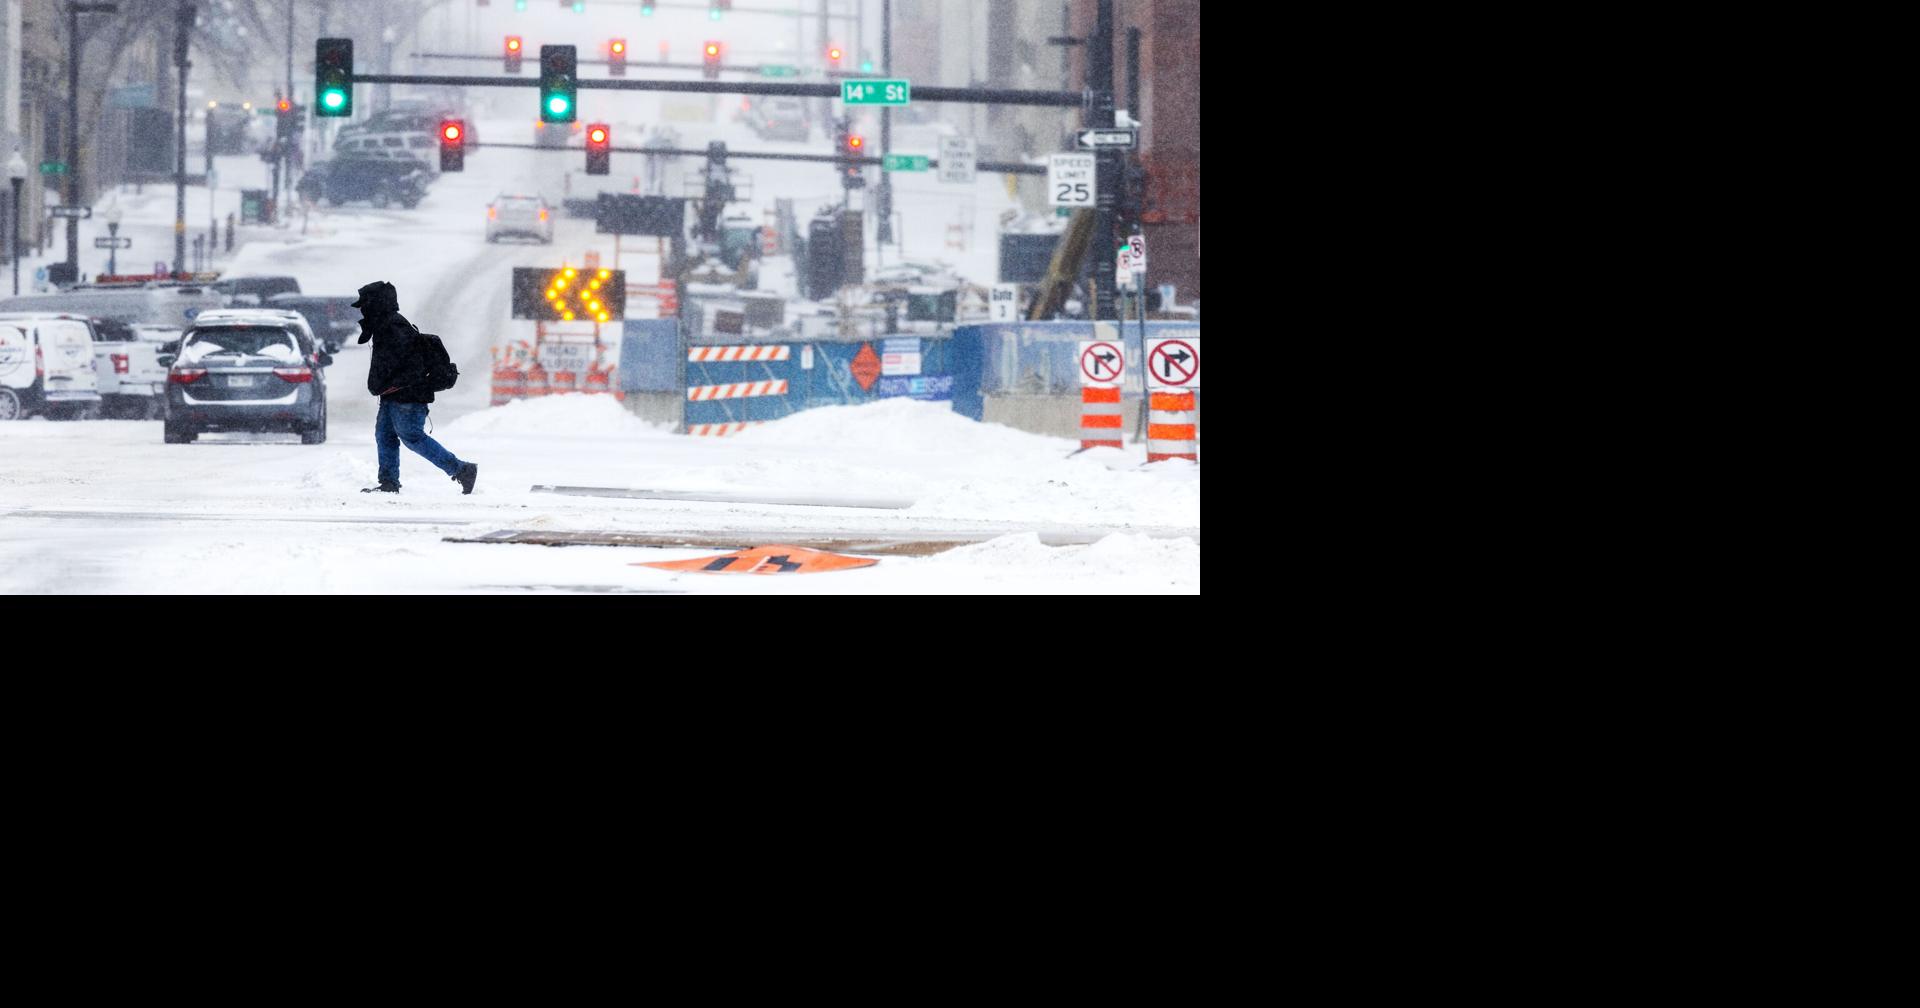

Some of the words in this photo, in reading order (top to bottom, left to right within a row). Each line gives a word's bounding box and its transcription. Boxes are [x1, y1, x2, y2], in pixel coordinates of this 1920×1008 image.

[846, 84, 875, 100] 14th
[884, 84, 905, 100] St
[1053, 158, 1092, 168] SPEED
[1055, 170, 1087, 180] LIMIT
[1056, 183, 1090, 202] 25
[992, 288, 1013, 301] Gate
[546, 346, 578, 356] ROAD
[542, 359, 585, 369] CLOSED
